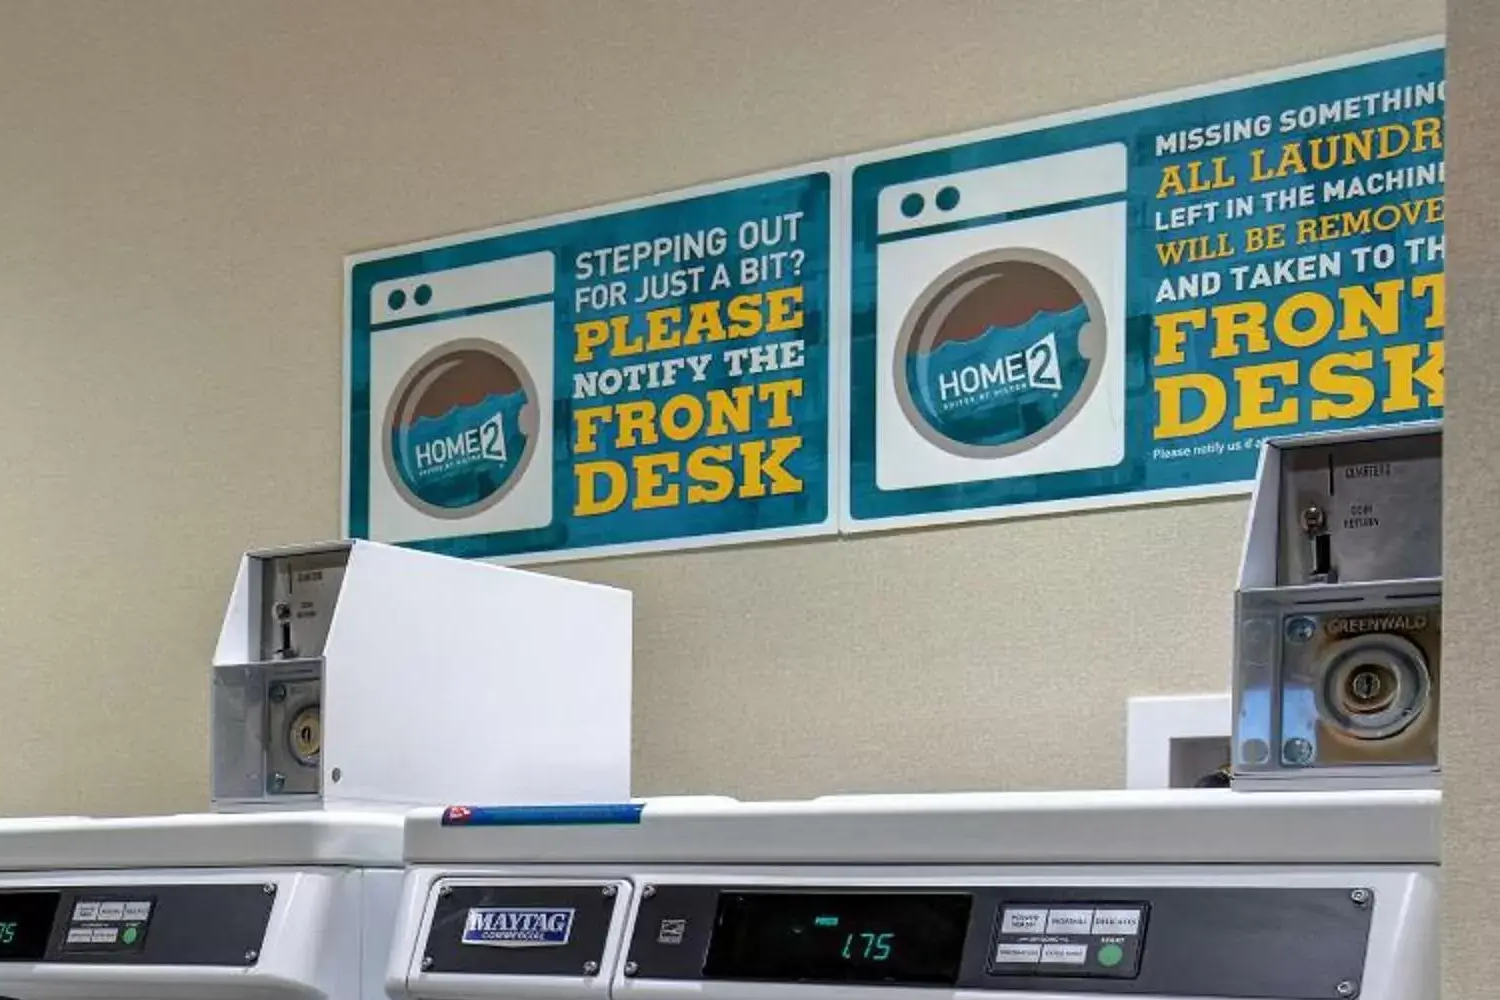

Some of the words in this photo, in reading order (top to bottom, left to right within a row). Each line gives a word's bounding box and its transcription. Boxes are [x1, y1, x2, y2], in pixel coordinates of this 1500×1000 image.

[1155, 115, 1271, 157] MISSING
[1156, 156, 1236, 199] ALL
[1250, 115, 1445, 183] LAUNDR
[1155, 201, 1220, 232] LEFT
[1227, 197, 1254, 219] IN
[1261, 185, 1315, 214] THE
[575, 227, 728, 281] STEPPING
[738, 211, 804, 249] OUT
[1155, 271, 1221, 303] AND
[1230, 250, 1341, 292] TAKEN
[1352, 242, 1394, 273] TO
[1156, 236, 1235, 266] WILL
[1246, 223, 1286, 252] BE
[576, 283, 627, 313] FOR
[635, 265, 706, 304] JUST
[710, 261, 731, 290] A
[739, 249, 806, 282] BIT?
[574, 286, 804, 363] PLEASE
[1153, 272, 1445, 366] FRONT
[572, 353, 713, 400] NOTIFY
[723, 339, 805, 375] THE
[1153, 340, 1445, 440] DESK
[573, 379, 803, 455] FRONT
[573, 436, 803, 517] DESK
[1153, 447, 1191, 459] Please
[1227, 441, 1242, 452] us
[1327, 614, 1429, 635] GREENWALD
[467, 912, 567, 931] MAYTAG
